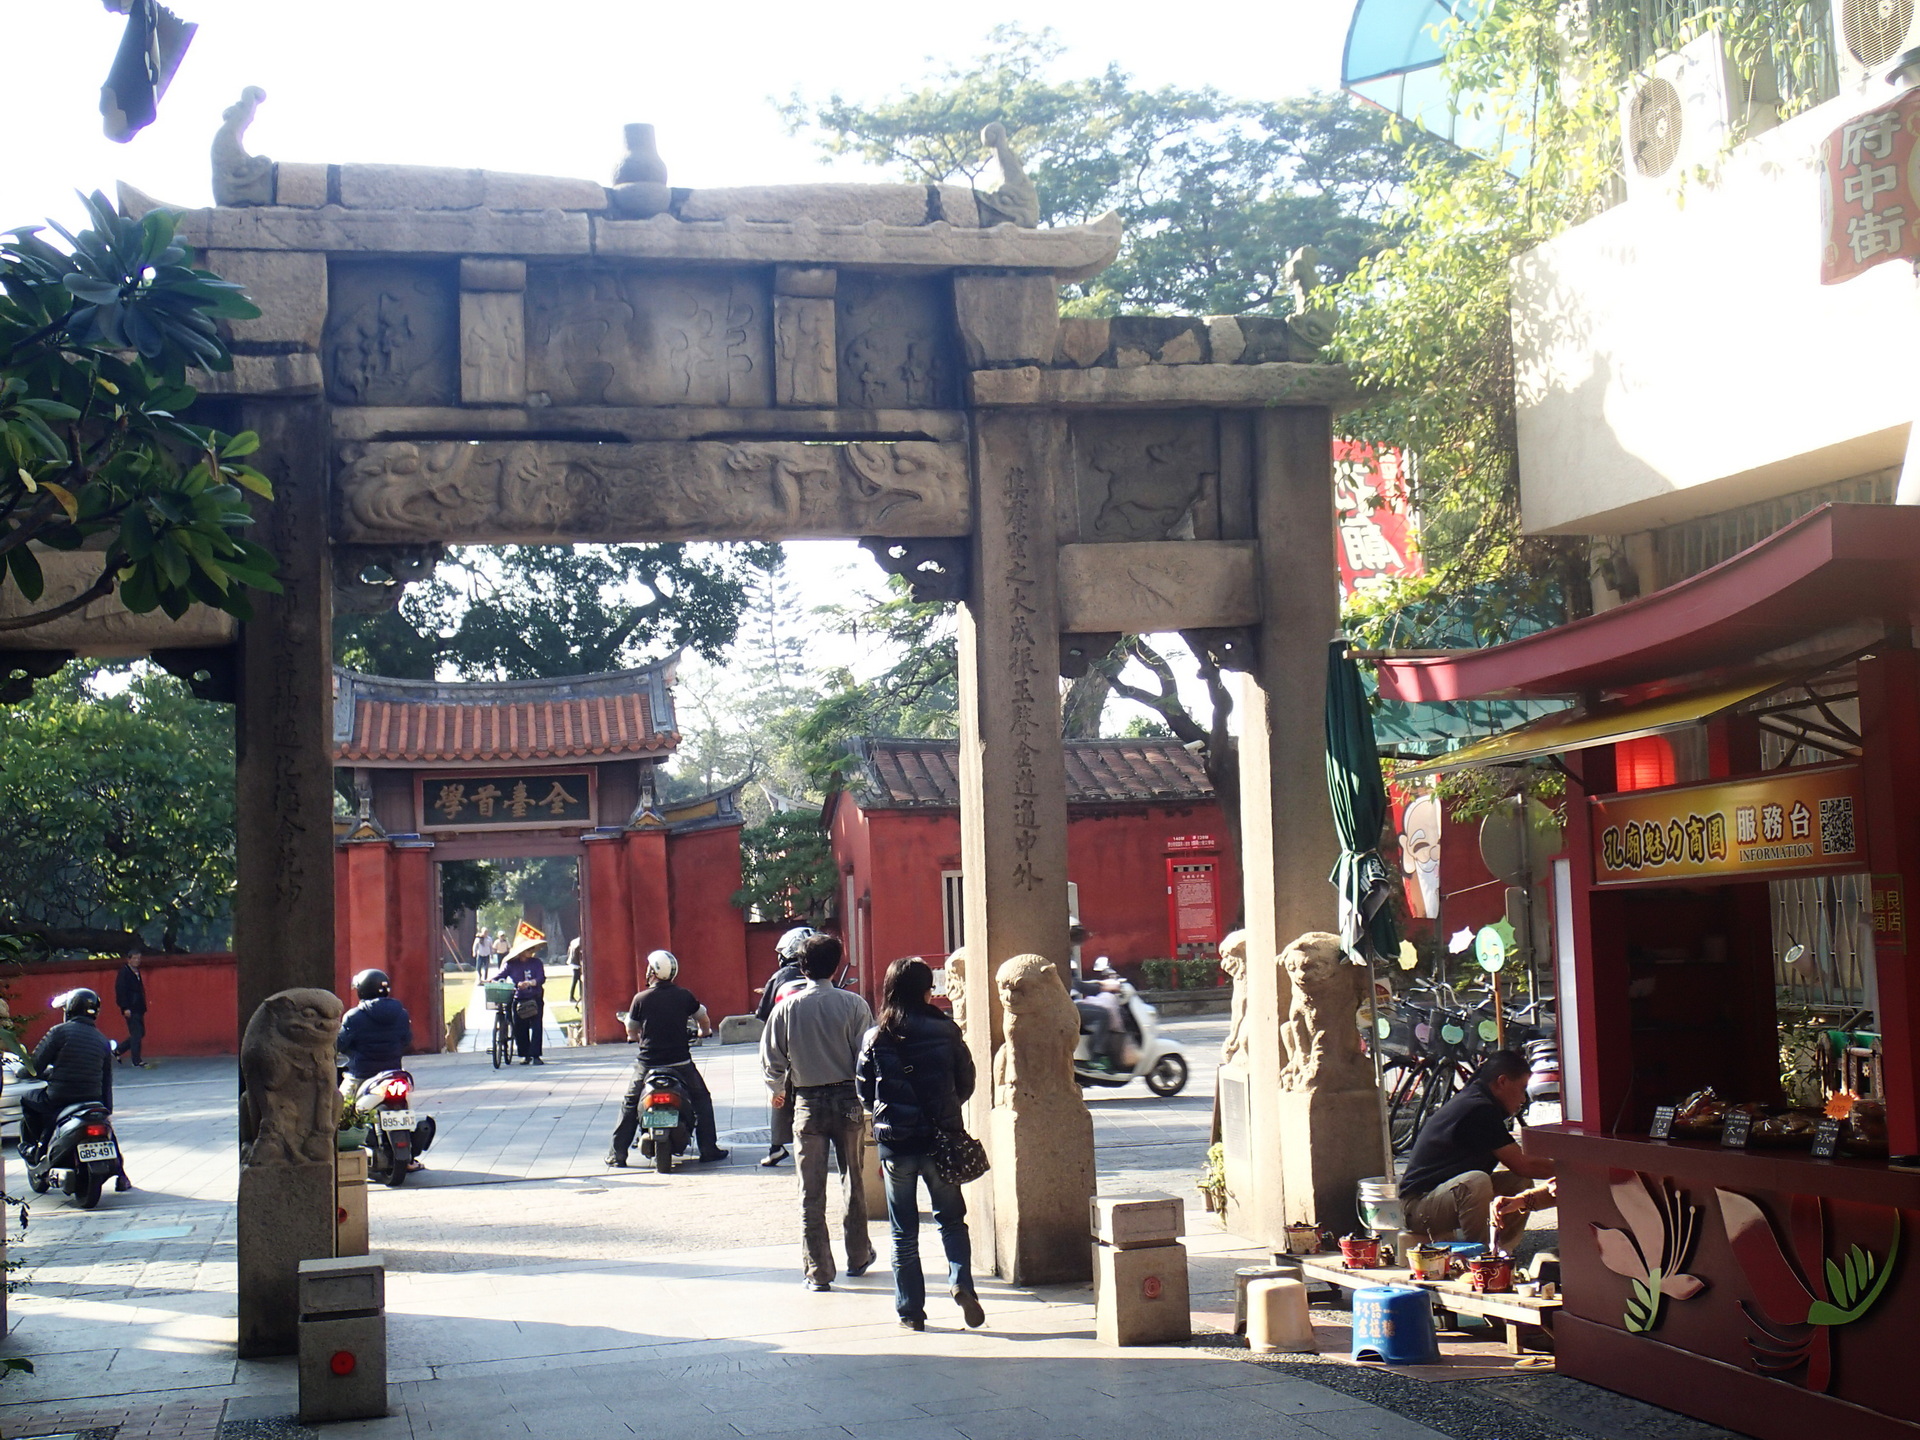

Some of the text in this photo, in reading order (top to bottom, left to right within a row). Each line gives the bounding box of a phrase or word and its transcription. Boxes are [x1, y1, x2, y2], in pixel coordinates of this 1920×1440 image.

[1840, 111, 1905, 264] 府中街
[434, 780, 579, 820] 全臺首學
[1603, 812, 1727, 870] 孔廟魅力商圈
[1736, 803, 1811, 844] 服務台
[1739, 843, 1813, 862] INFORMATION
[80, 1146, 114, 1159] GB5-491
